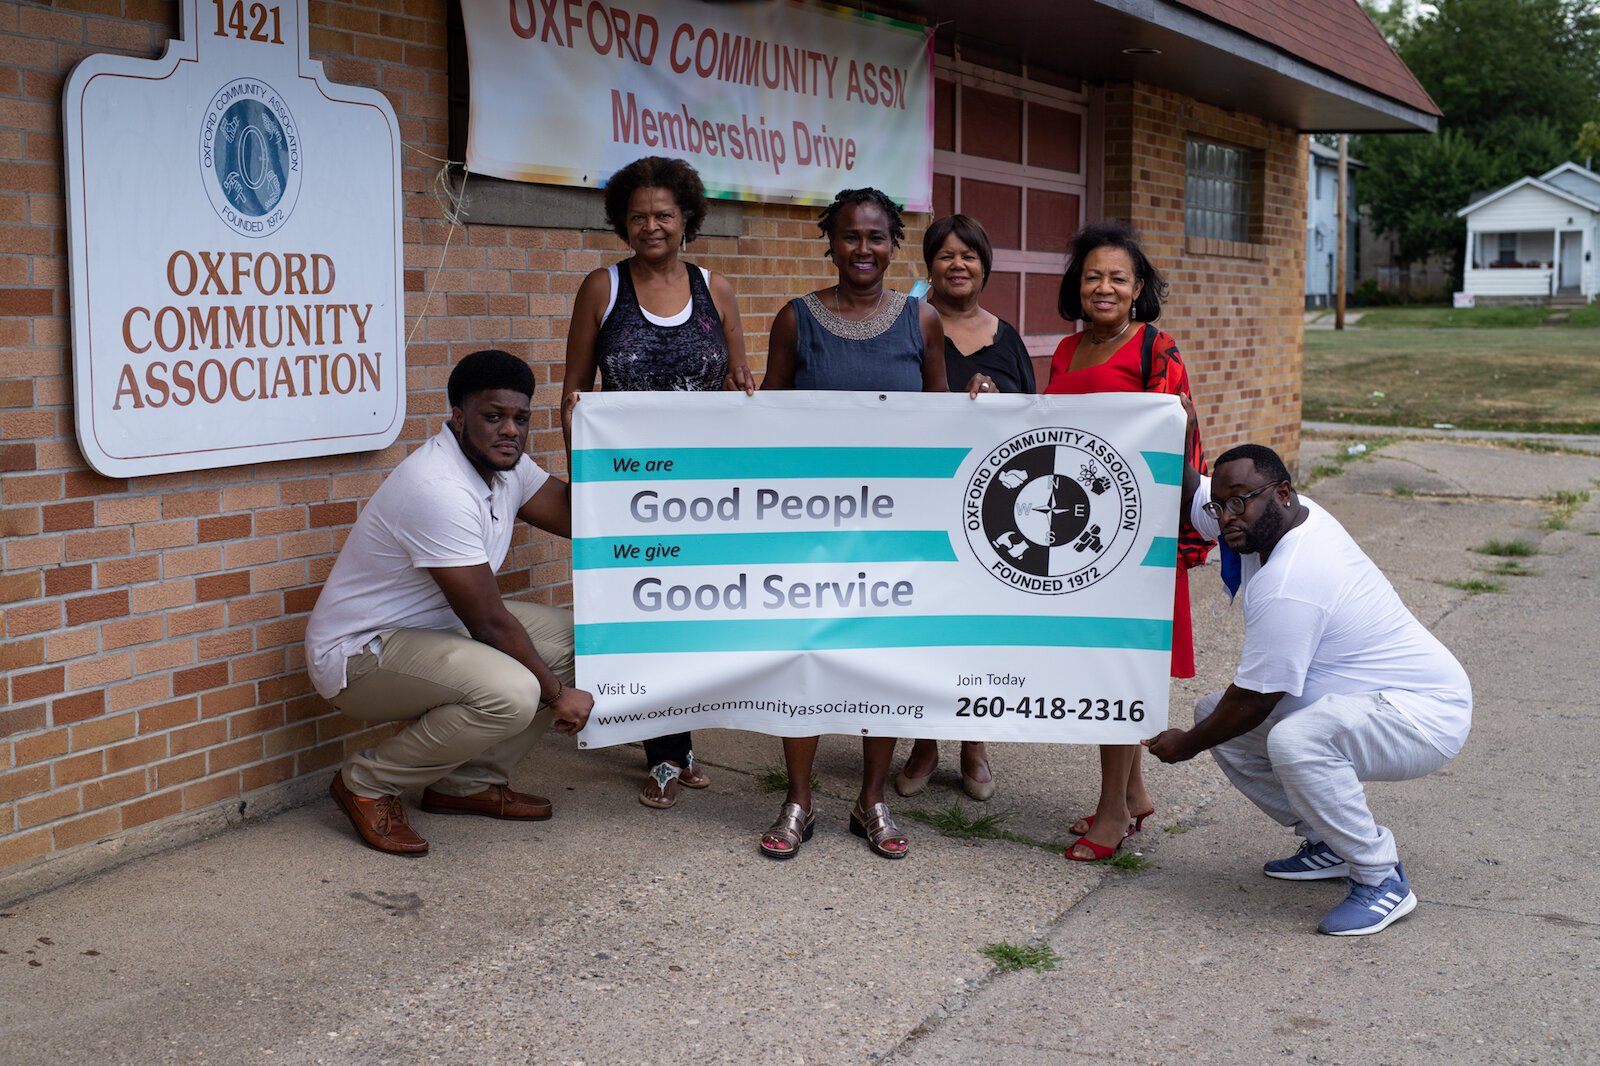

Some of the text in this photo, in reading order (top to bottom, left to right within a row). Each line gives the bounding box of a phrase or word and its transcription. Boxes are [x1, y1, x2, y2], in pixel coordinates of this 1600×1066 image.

[213, 0, 285, 45] 1421
[508, 0, 907, 110] OXFORD COMMUNITY ASSN
[204, 112, 217, 168] OXFORD
[215, 83, 267, 110] COMMUNITY
[611, 89, 857, 174] Membership Drive
[221, 206, 284, 232] FOUNDED 1972
[166, 250, 336, 297] OXFORD
[122, 304, 373, 354] COMMUNITY
[112, 352, 382, 410] ASSOCIATION
[612, 457, 674, 472] We are
[967, 431, 1138, 531] OXFORD COMMUNITY ASSOCIATION
[630, 485, 895, 527] Good People
[1074, 504, 1085, 517] E
[613, 544, 681, 561] We give
[632, 571, 914, 612] Good Service
[992, 561, 1101, 592] FOUNDED 1972
[597, 682, 647, 696] Visit Us
[956, 673, 1026, 688] Join Today
[598, 698, 925, 726] www.oxfordcommunityassociation.org
[955, 696, 1146, 723] 260-418-2316
